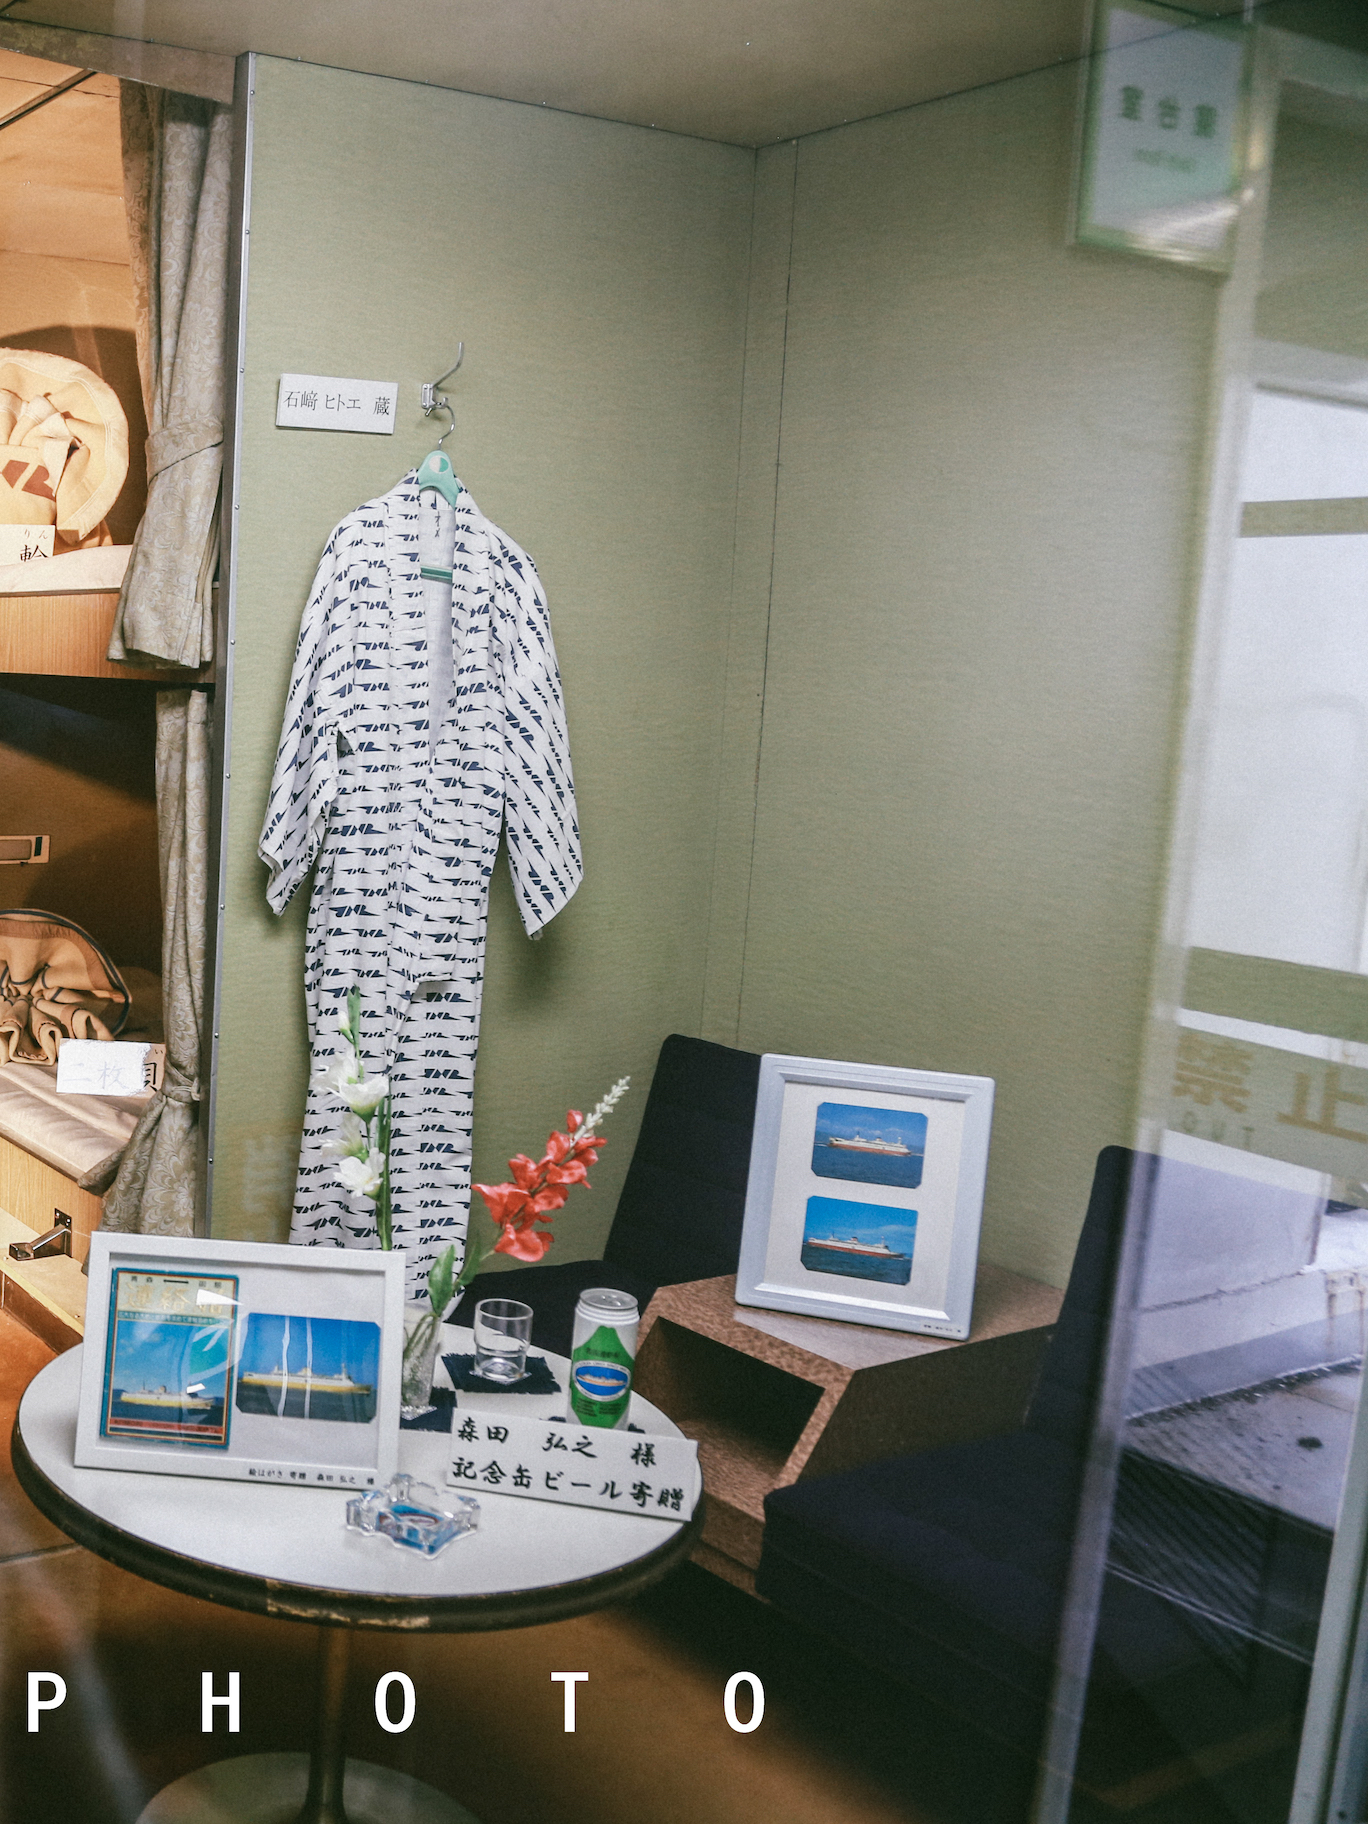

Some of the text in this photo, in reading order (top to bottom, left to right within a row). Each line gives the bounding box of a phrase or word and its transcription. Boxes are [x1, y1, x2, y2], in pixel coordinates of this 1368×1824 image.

[325, 394, 362, 412] ヒトエ
[373, 396, 391, 416] 蔵
[458, 1416, 658, 1468] 森田 弘之 様
[452, 1456, 685, 1513] 記念缶ビール寄贈
